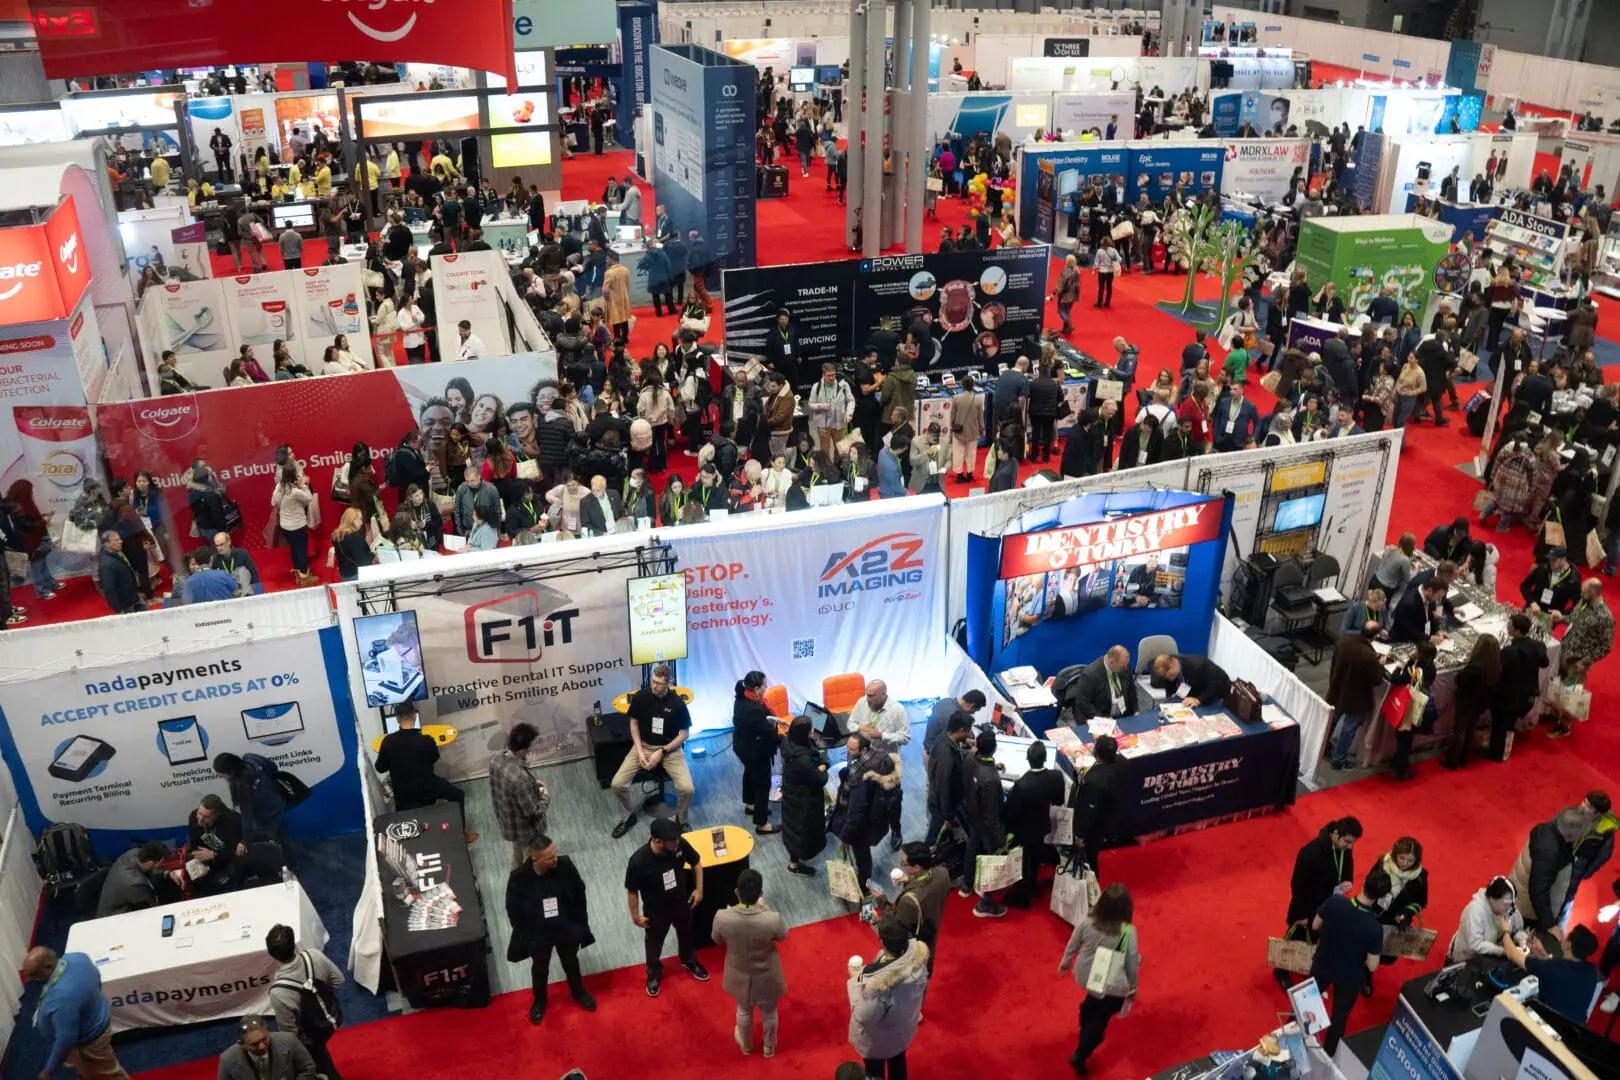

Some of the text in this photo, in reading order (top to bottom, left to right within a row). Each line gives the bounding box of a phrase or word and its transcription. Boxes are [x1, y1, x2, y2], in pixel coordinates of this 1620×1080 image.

[512, 16, 533, 36] e
[1240, 145, 1288, 156] MDRXLAW
[1501, 210, 1524, 227] ADA
[1526, 217, 1555, 235] Store
[872, 255, 924, 266] POWER
[797, 285, 838, 296] TRADE-IN
[20, 340, 45, 349] SOON
[798, 334, 838, 346] ERVICING
[1303, 335, 1322, 348] ADA
[140, 405, 191, 420] Colgate
[29, 417, 87, 428] Colgate
[41, 463, 79, 475] Total
[233, 463, 278, 478] Futur
[1024, 504, 1207, 556] DENTISTRY
[819, 532, 924, 582] A2Z
[1075, 531, 1164, 566] TODAY
[681, 563, 749, 585] STOP.
[818, 569, 923, 598] IMAGING
[687, 596, 774, 616] esterday's.
[687, 614, 772, 631] echnology.
[84, 658, 243, 696] nadapayments
[431, 657, 625, 697] Proactive Dental IT Support
[40, 672, 300, 727] ACCEPT CREDIT CARDS AT 0%
[456, 676, 604, 709] Worth Smiling About
[278, 755, 321, 770] Reporting
[291, 748, 313, 758] Links
[172, 767, 213, 780] Invoicing
[1143, 757, 1243, 788] DENTISTRY
[52, 780, 133, 800] Payment Terminal
[160, 778, 191, 789] Virtual
[59, 788, 131, 807] Recurring Billing
[111, 973, 271, 1008] adapayments
